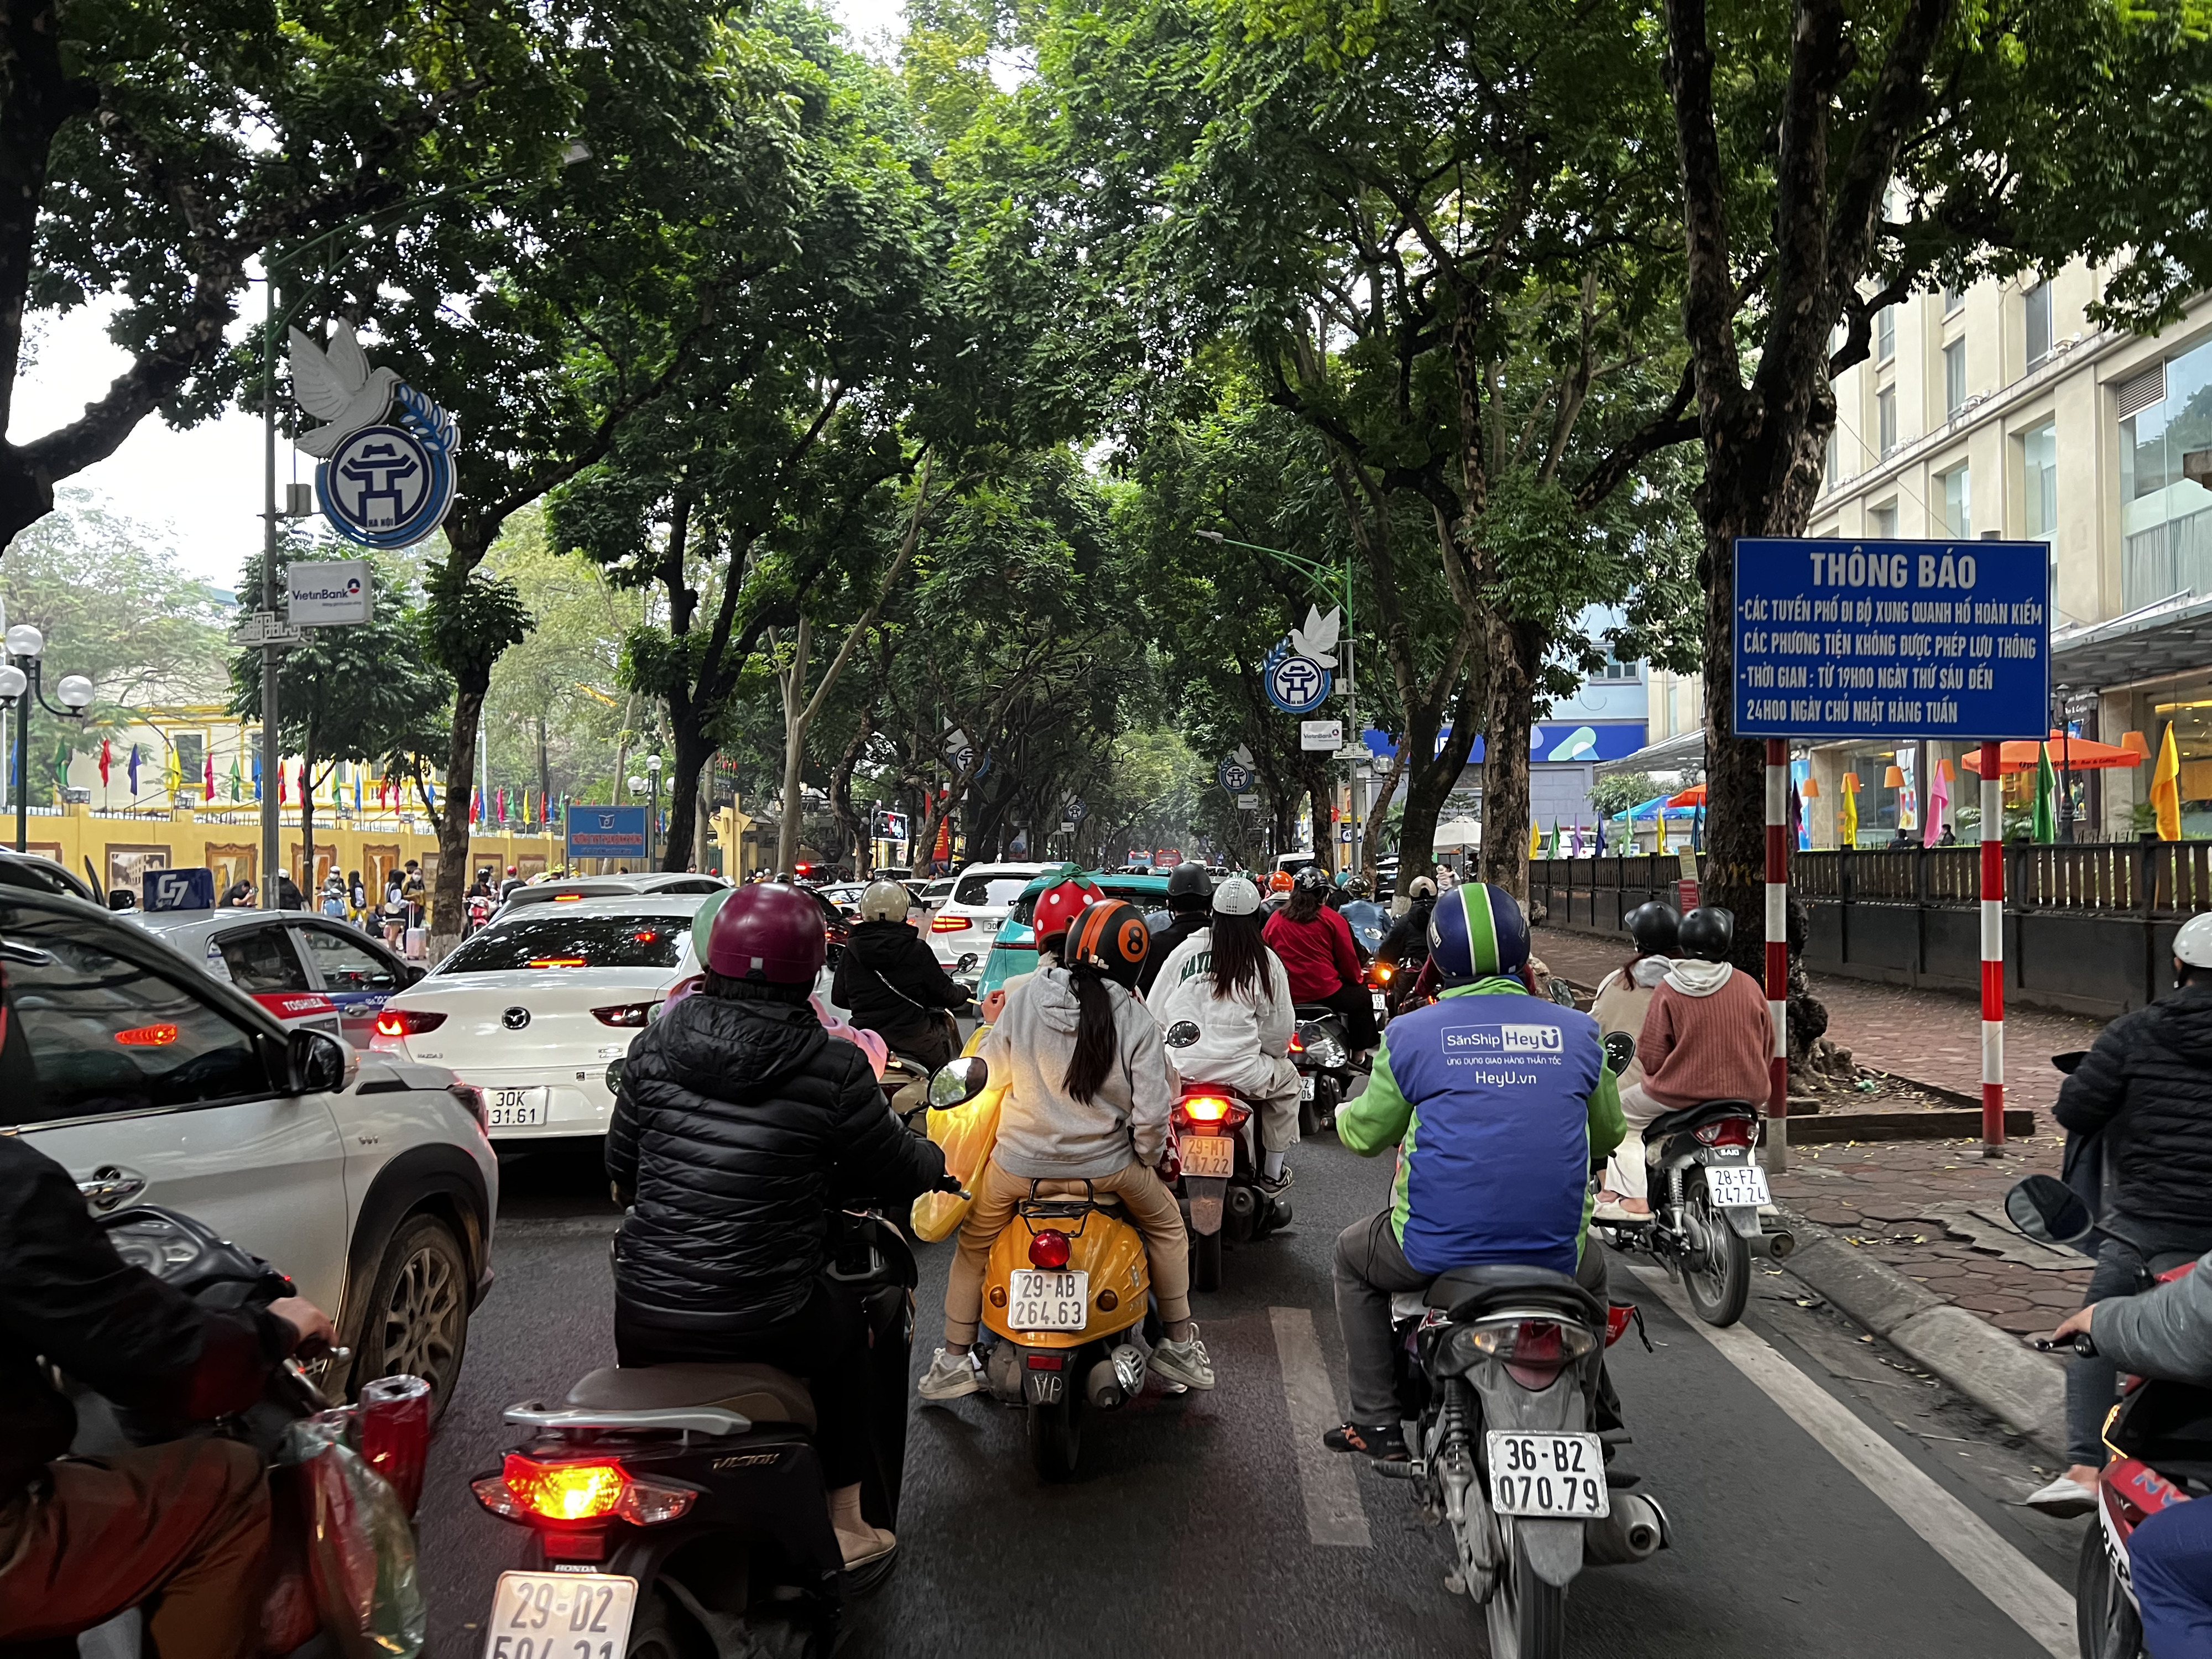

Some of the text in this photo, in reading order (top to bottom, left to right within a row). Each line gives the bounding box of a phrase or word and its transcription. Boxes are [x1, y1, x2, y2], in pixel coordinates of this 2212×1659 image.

[1810, 545, 1976, 589] THÔNG BÁO
[292, 588, 348, 600] VietinBank
[1772, 593, 1811, 622] TUYẾN
[1814, 593, 1839, 622] PHỐ
[1841, 600, 1853, 623] ĐI
[1856, 596, 1872, 627] BỘ
[1875, 601, 1908, 623] XUNG
[1912, 601, 1952, 624] QUANH
[1975, 598, 2007, 624] HOÀN
[2011, 596, 2042, 625] KIẾM
[1744, 626, 2036, 661] CÁC PHƯƠNG TIỆN KHÔNG ĐƯỢC PHÉP LƯU THÔNG
[1818, 661, 1835, 688] TỪ
[1837, 667, 1874, 688] 19H00
[1878, 662, 1908, 689] NGÀY
[1912, 662, 1937, 689] THỨ
[1939, 662, 1963, 690] SÁU
[1746, 699, 1787, 721] 24H00
[1791, 695, 1822, 722] NGÀY
[1825, 692, 1849, 722] CHỦ
[1853, 695, 1885, 726] NHẬT
[1888, 695, 1922, 723] HÀNG
[157, 874, 189, 906] G7
[1127, 926, 1143, 954] 8
[282, 997, 327, 1012] TOSHIBA
[1447, 1033, 1500, 1047] SănShip
[1475, 1071, 1537, 1088] HeyU.vn
[495, 1091, 525, 1107] 30K
[487, 1108, 535, 1125] 31.61
[1188, 1139, 1225, 1156] 29-M1
[1715, 1186, 1765, 1203] 247.24
[1022, 1274, 1075, 1298] 29-AB
[1014, 1301, 1081, 1326] 264.63
[1505, 1438, 1586, 1473] 36-B2
[1499, 1475, 1600, 1512] 070.79
[555, 1564, 598, 1573] HONDA
[510, 1582, 613, 1633] 29-D2
